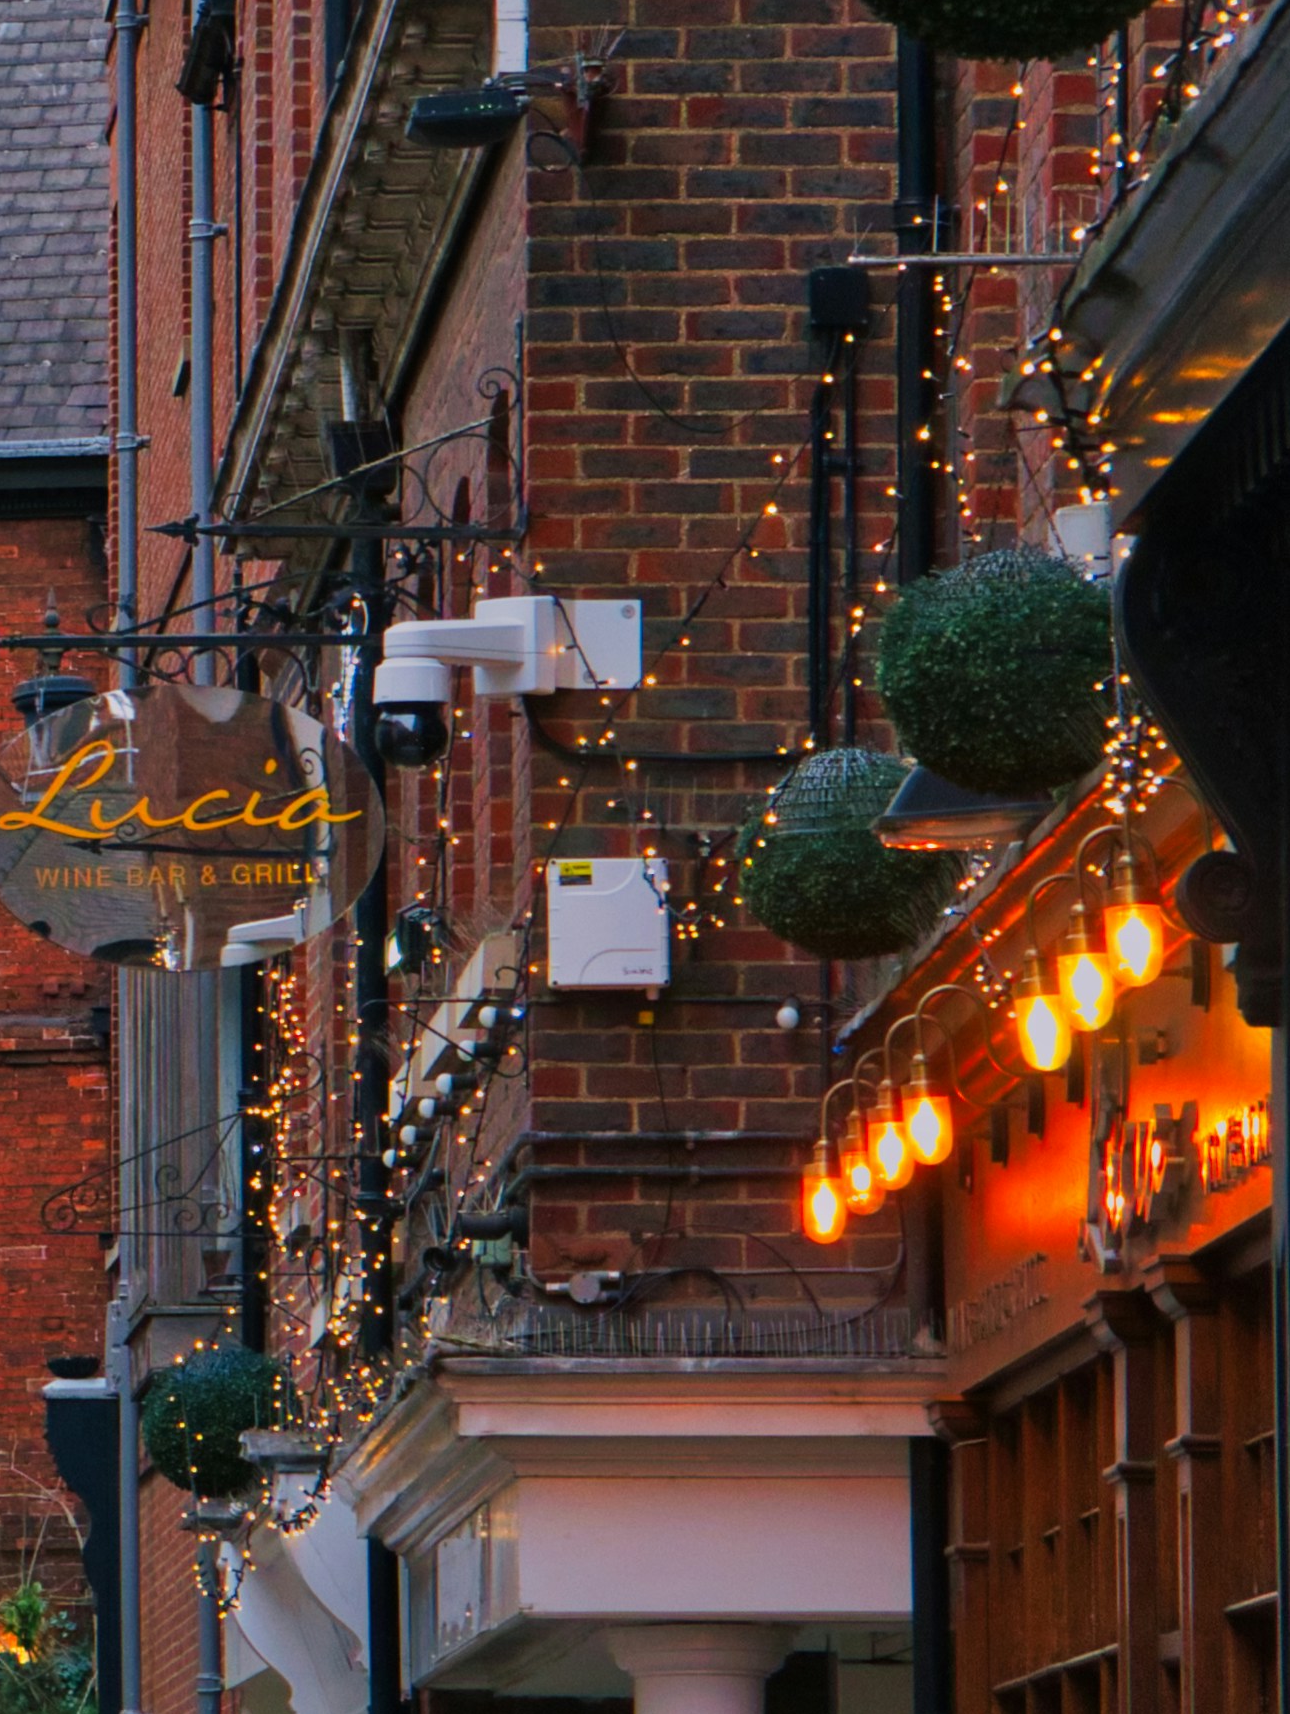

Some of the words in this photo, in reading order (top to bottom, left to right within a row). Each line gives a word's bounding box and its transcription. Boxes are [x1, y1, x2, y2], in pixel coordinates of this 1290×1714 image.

[35, 866, 113, 887] WINE
[126, 865, 187, 886] BAR
[200, 864, 217, 886] &
[232, 862, 319, 885] GRILL
